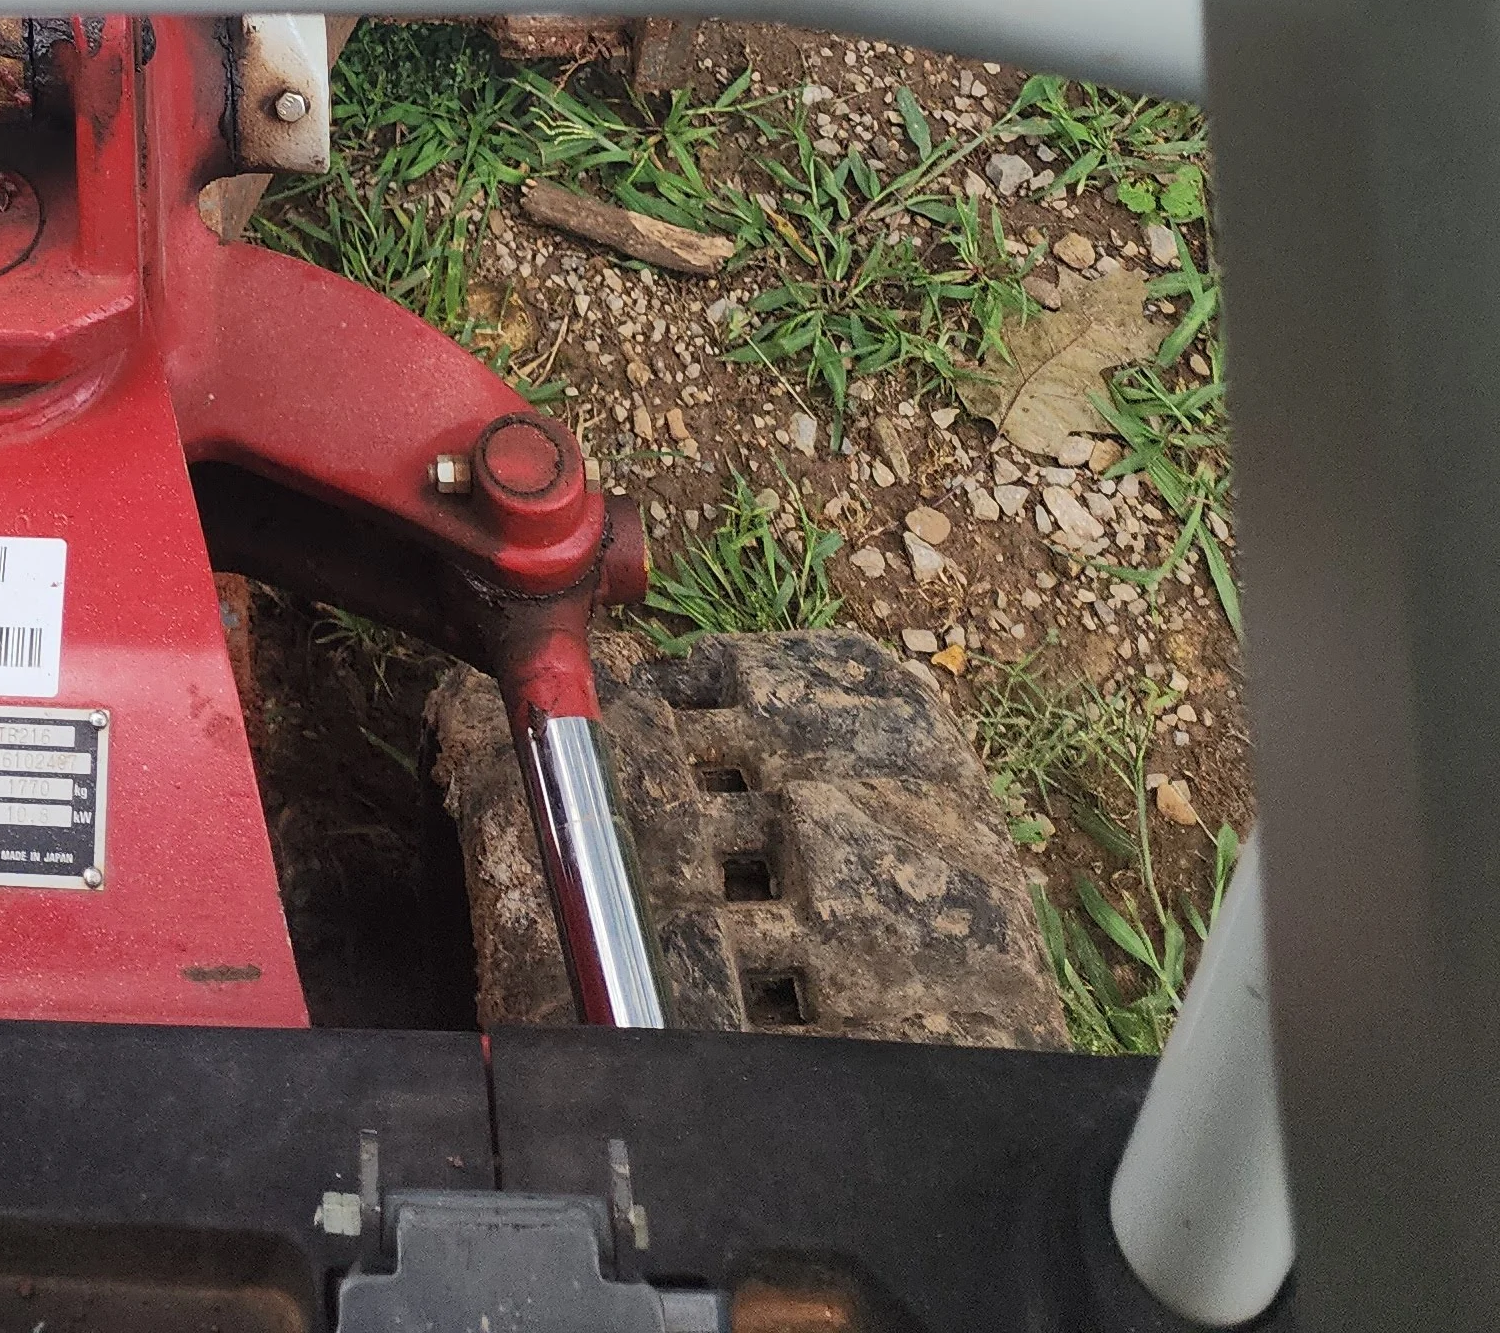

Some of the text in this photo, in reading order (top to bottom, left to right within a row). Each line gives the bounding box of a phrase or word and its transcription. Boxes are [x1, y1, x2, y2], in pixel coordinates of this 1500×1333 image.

[8, 779, 88, 800] 1770 kg
[73, 810, 93, 825] kW
[1, 849, 74, 864] MADE IN JAPAN
